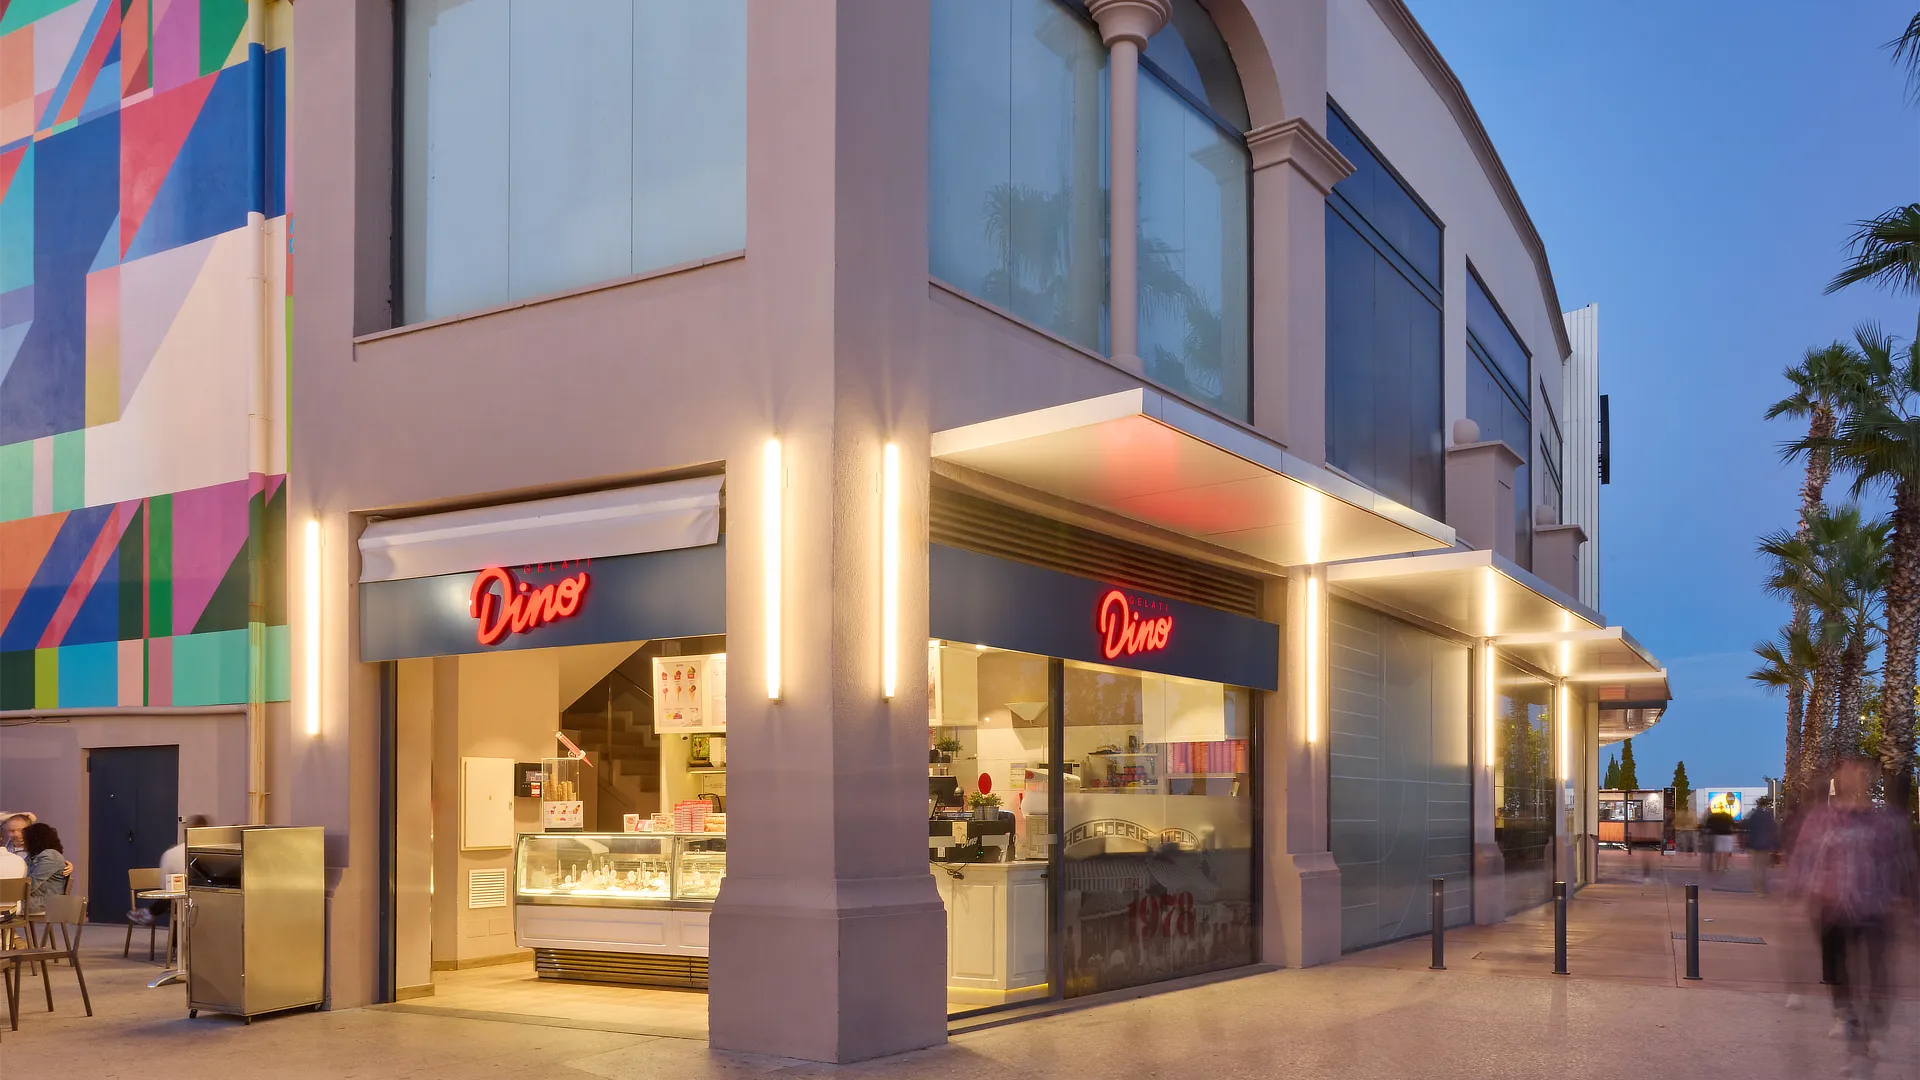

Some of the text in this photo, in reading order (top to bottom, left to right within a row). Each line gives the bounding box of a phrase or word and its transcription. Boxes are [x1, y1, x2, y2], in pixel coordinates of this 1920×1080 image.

[469, 566, 591, 646] Dino
[1098, 590, 1173, 659] Dino
[1129, 595, 1169, 612] GELATI
[1064, 822, 1149, 846] HELADERIA
[1127, 891, 1195, 941] 1978
